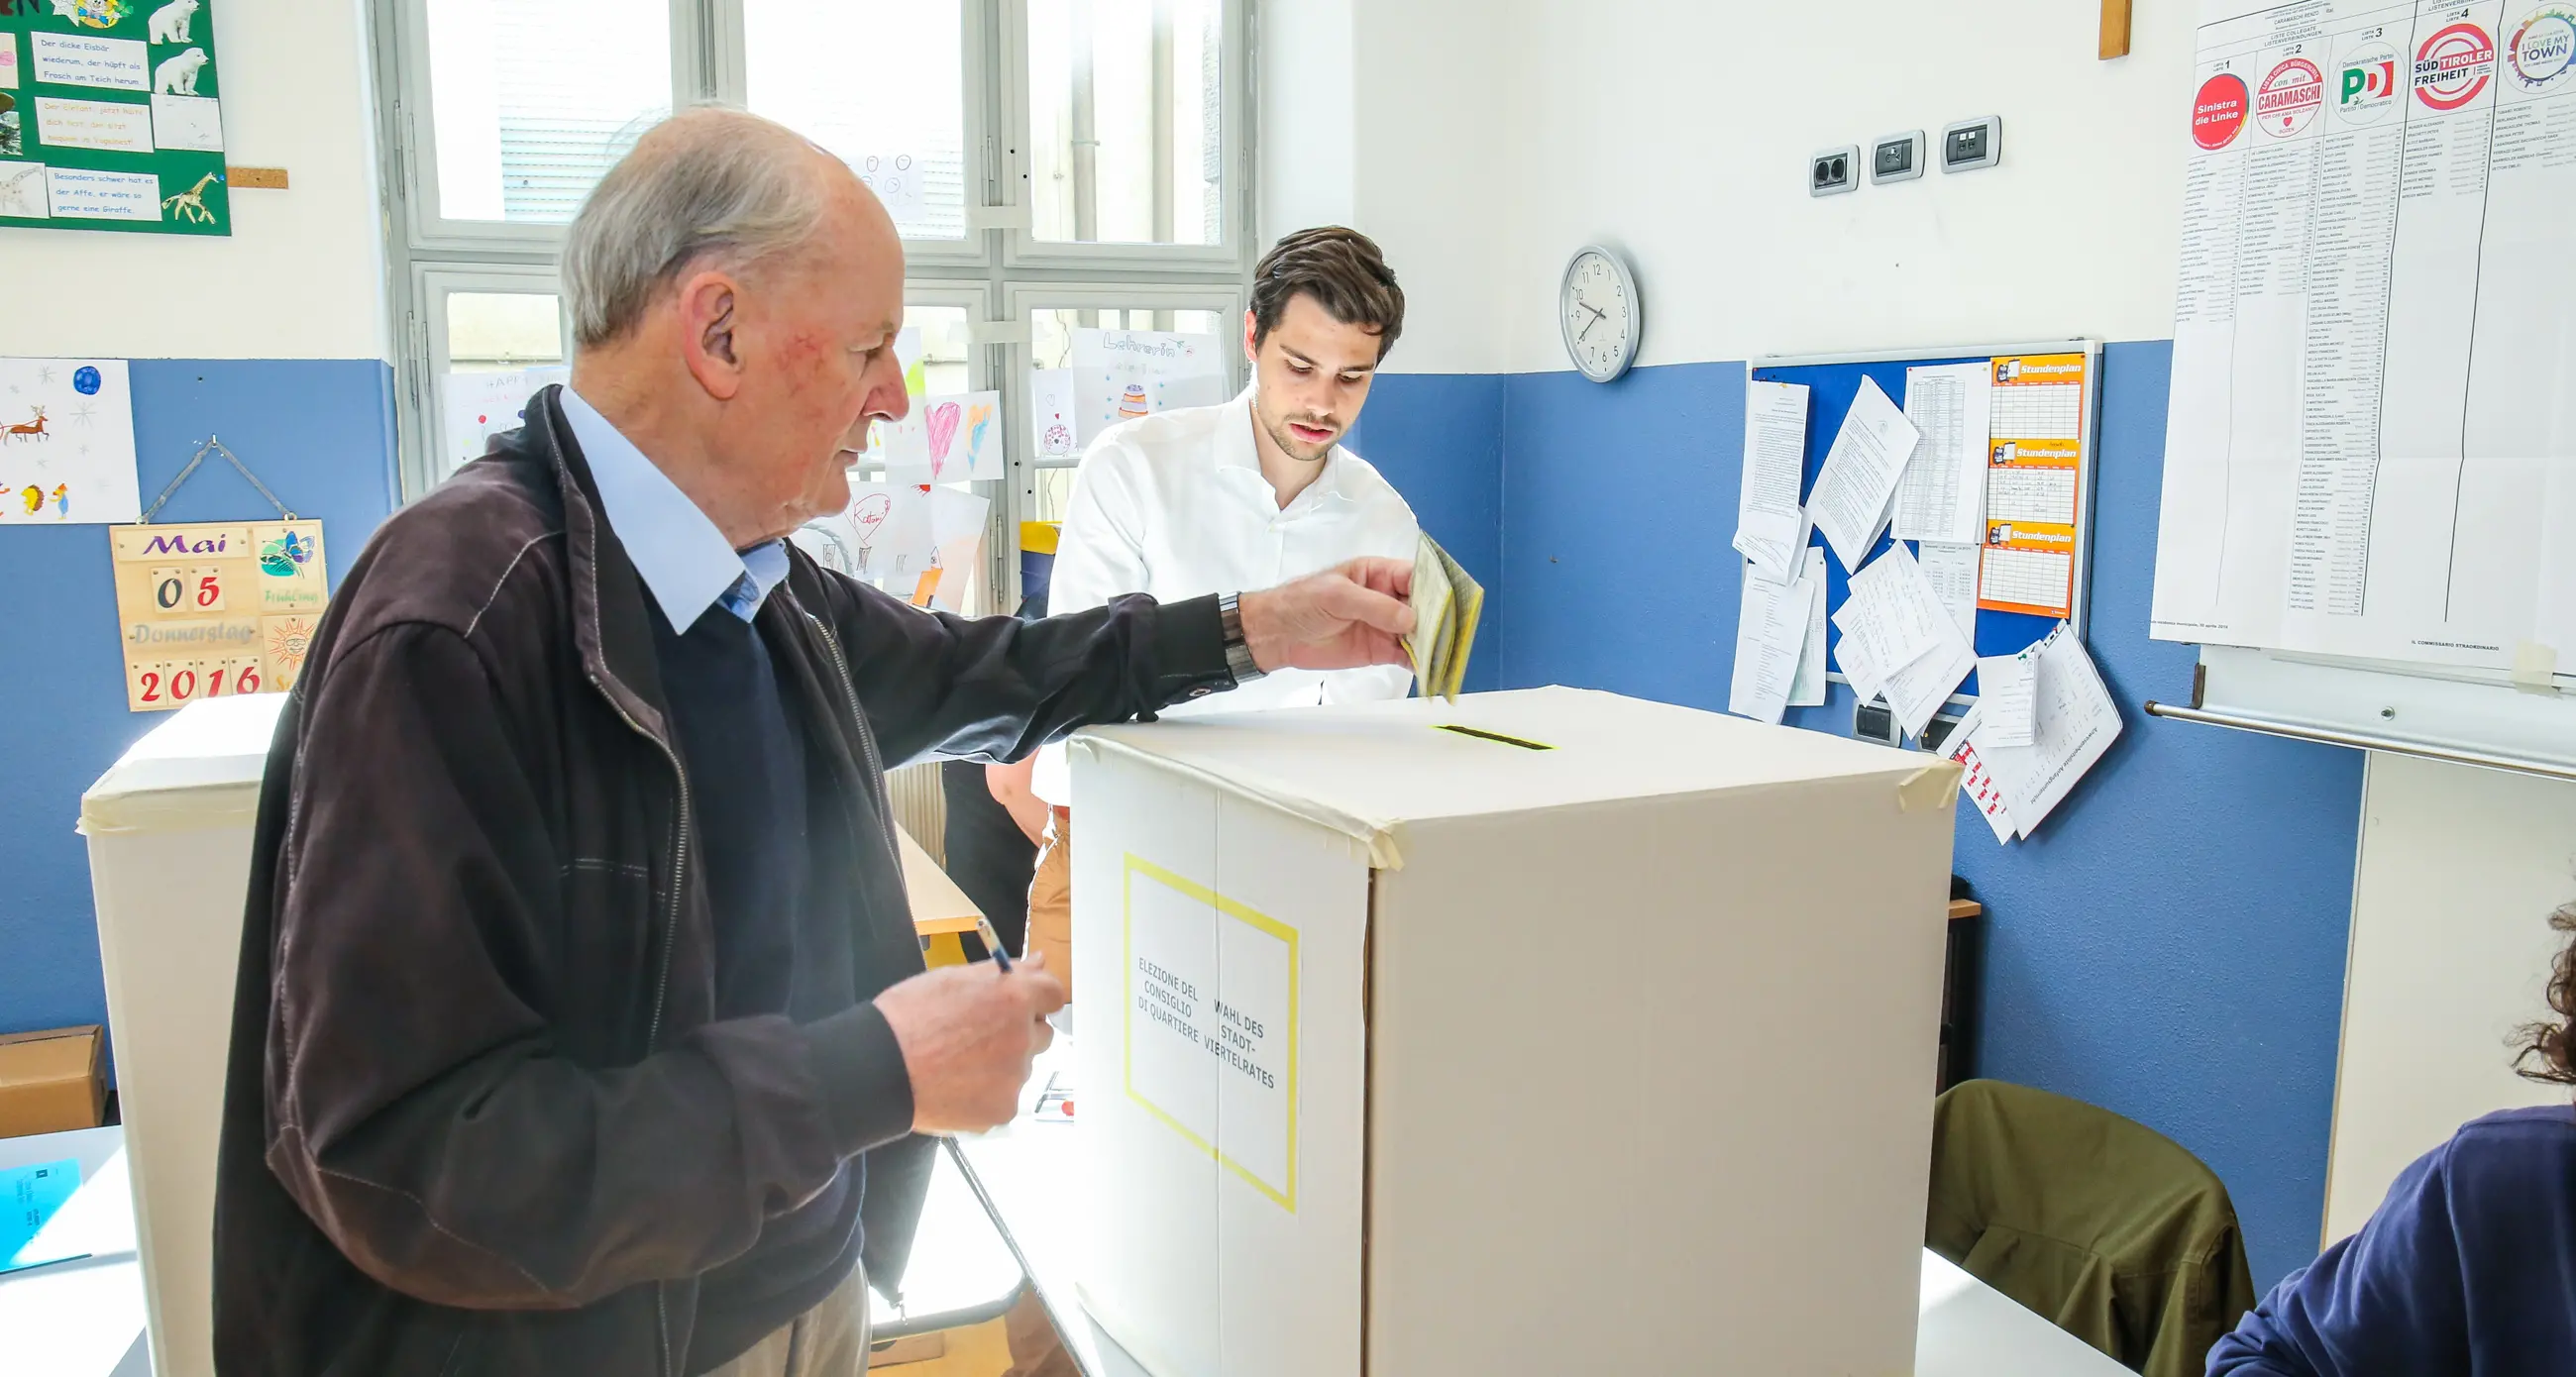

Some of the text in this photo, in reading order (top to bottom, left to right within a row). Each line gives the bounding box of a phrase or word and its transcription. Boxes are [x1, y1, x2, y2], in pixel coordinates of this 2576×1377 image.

[2274, 14, 2304, 25] CARAMASCHI
[2461, 8, 2469, 19] 4
[2286, 26, 2316, 37] COLLEGATE
[2375, 28, 2383, 38] 3
[2264, 30, 2322, 47] LISTENVERBINDUNGEN
[2527, 38, 2551, 50] LOVE
[2554, 34, 2570, 46] MY
[59, 40, 80, 50] dicke
[2295, 45, 2303, 54] 2
[2522, 43, 2567, 62] TOWN
[104, 60, 127, 69] hüpft
[2225, 59, 2230, 68] 1
[2342, 56, 2379, 68] Demokratische
[2415, 50, 2493, 73] SÜD TIROLER
[44, 70, 71, 79] Frosch
[90, 74, 111, 83] Teich
[2262, 60, 2318, 90] LISTA CIVICA BÜRGERLISTE
[2274, 73, 2307, 88] con mit
[2414, 67, 2469, 86] FREIHEIT
[2341, 60, 2394, 105] PD
[2258, 84, 2320, 110] CARAMASCHI
[2198, 99, 2237, 114] Sinistra
[2293, 106, 2314, 115] BOLZANO
[2359, 99, 2392, 110] Democratico
[2195, 111, 2238, 126] die Linke
[54, 172, 95, 182] Besonders
[98, 174, 126, 183] schwer
[1592, 264, 1601, 275] 12
[1581, 271, 1589, 283] 11
[1575, 288, 1584, 301] 10
[1616, 285, 1622, 297] 2
[1575, 310, 1580, 321] 9
[1622, 306, 1627, 318] 3
[1620, 329, 1625, 340] 4
[1103, 331, 1176, 358] Lehrerin
[1590, 346, 1595, 358] 7
[1602, 351, 1607, 363] 6
[1613, 346, 1619, 358] 5
[2021, 364, 2082, 374] Stundenplan
[2016, 448, 2077, 460] Stundenplan
[2011, 529, 2072, 544] Stundenplan
[143, 533, 227, 555] Mai
[134, 622, 251, 645] Donnerstag
[1138, 956, 1199, 1003] ELEZIONE DEL
[1143, 979, 1193, 1019] CONSIGLIO
[1137, 995, 1200, 1043] DI QUARTIERE
[1214, 999, 1264, 1039] WAHL DES
[1220, 1023, 1256, 1054] STADT-
[1203, 1034, 1275, 1090] VIERTELRATES
